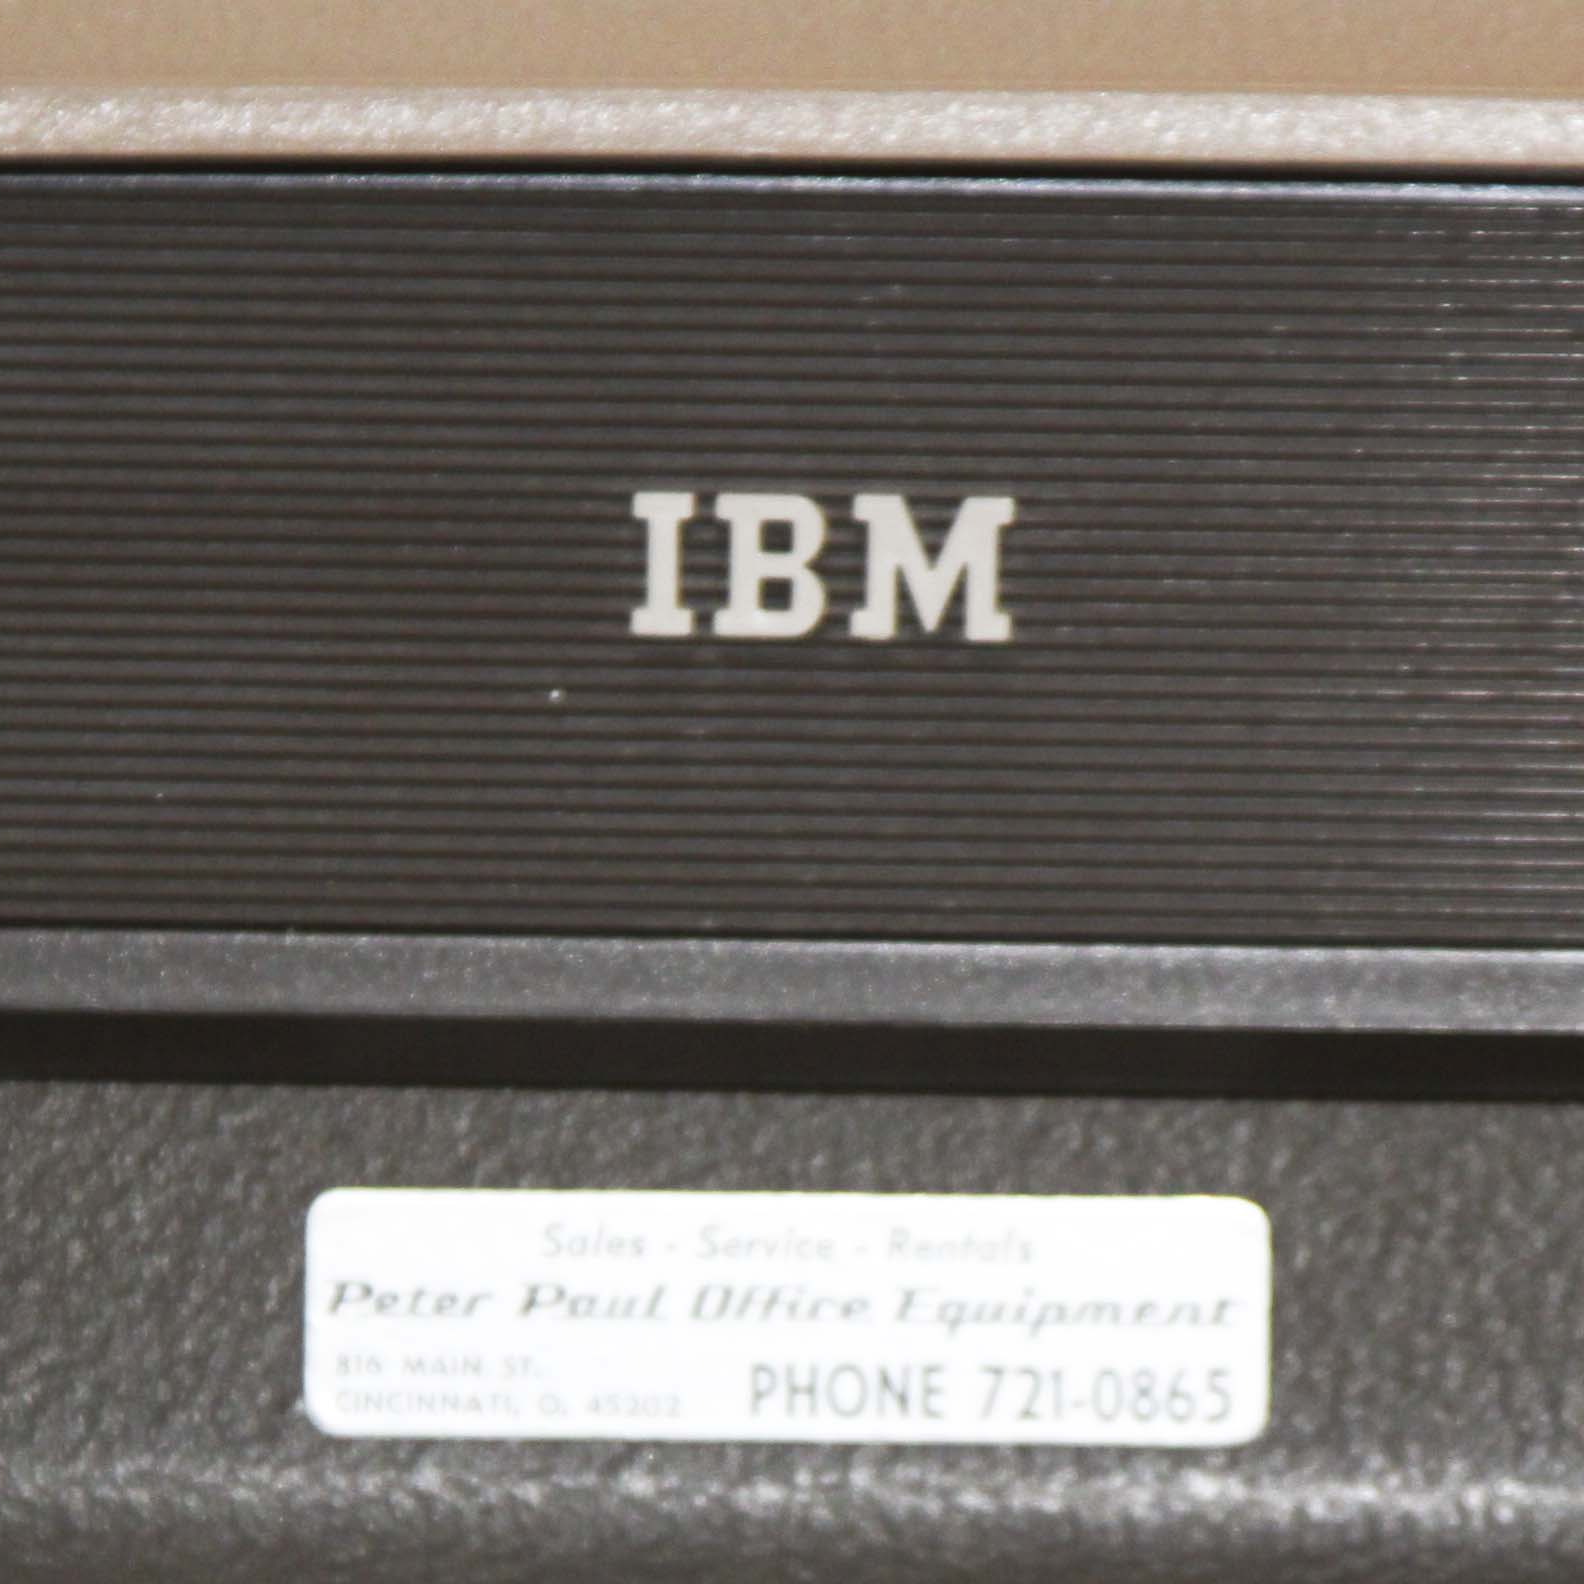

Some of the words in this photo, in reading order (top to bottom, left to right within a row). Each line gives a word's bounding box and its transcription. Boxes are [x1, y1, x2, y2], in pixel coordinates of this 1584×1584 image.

[629, 491, 1015, 642] IBM
[540, 1223, 647, 1262] Sales
[695, 1226, 835, 1262] Service
[886, 1229, 1039, 1263] Rentals
[324, 1280, 494, 1319] Peter
[515, 1283, 670, 1321] Paul
[688, 1284, 874, 1325] Office
[893, 1287, 1239, 1339] Equipment
[748, 1363, 946, 1419] PHONE
[977, 1365, 1234, 1423] 721-0865
